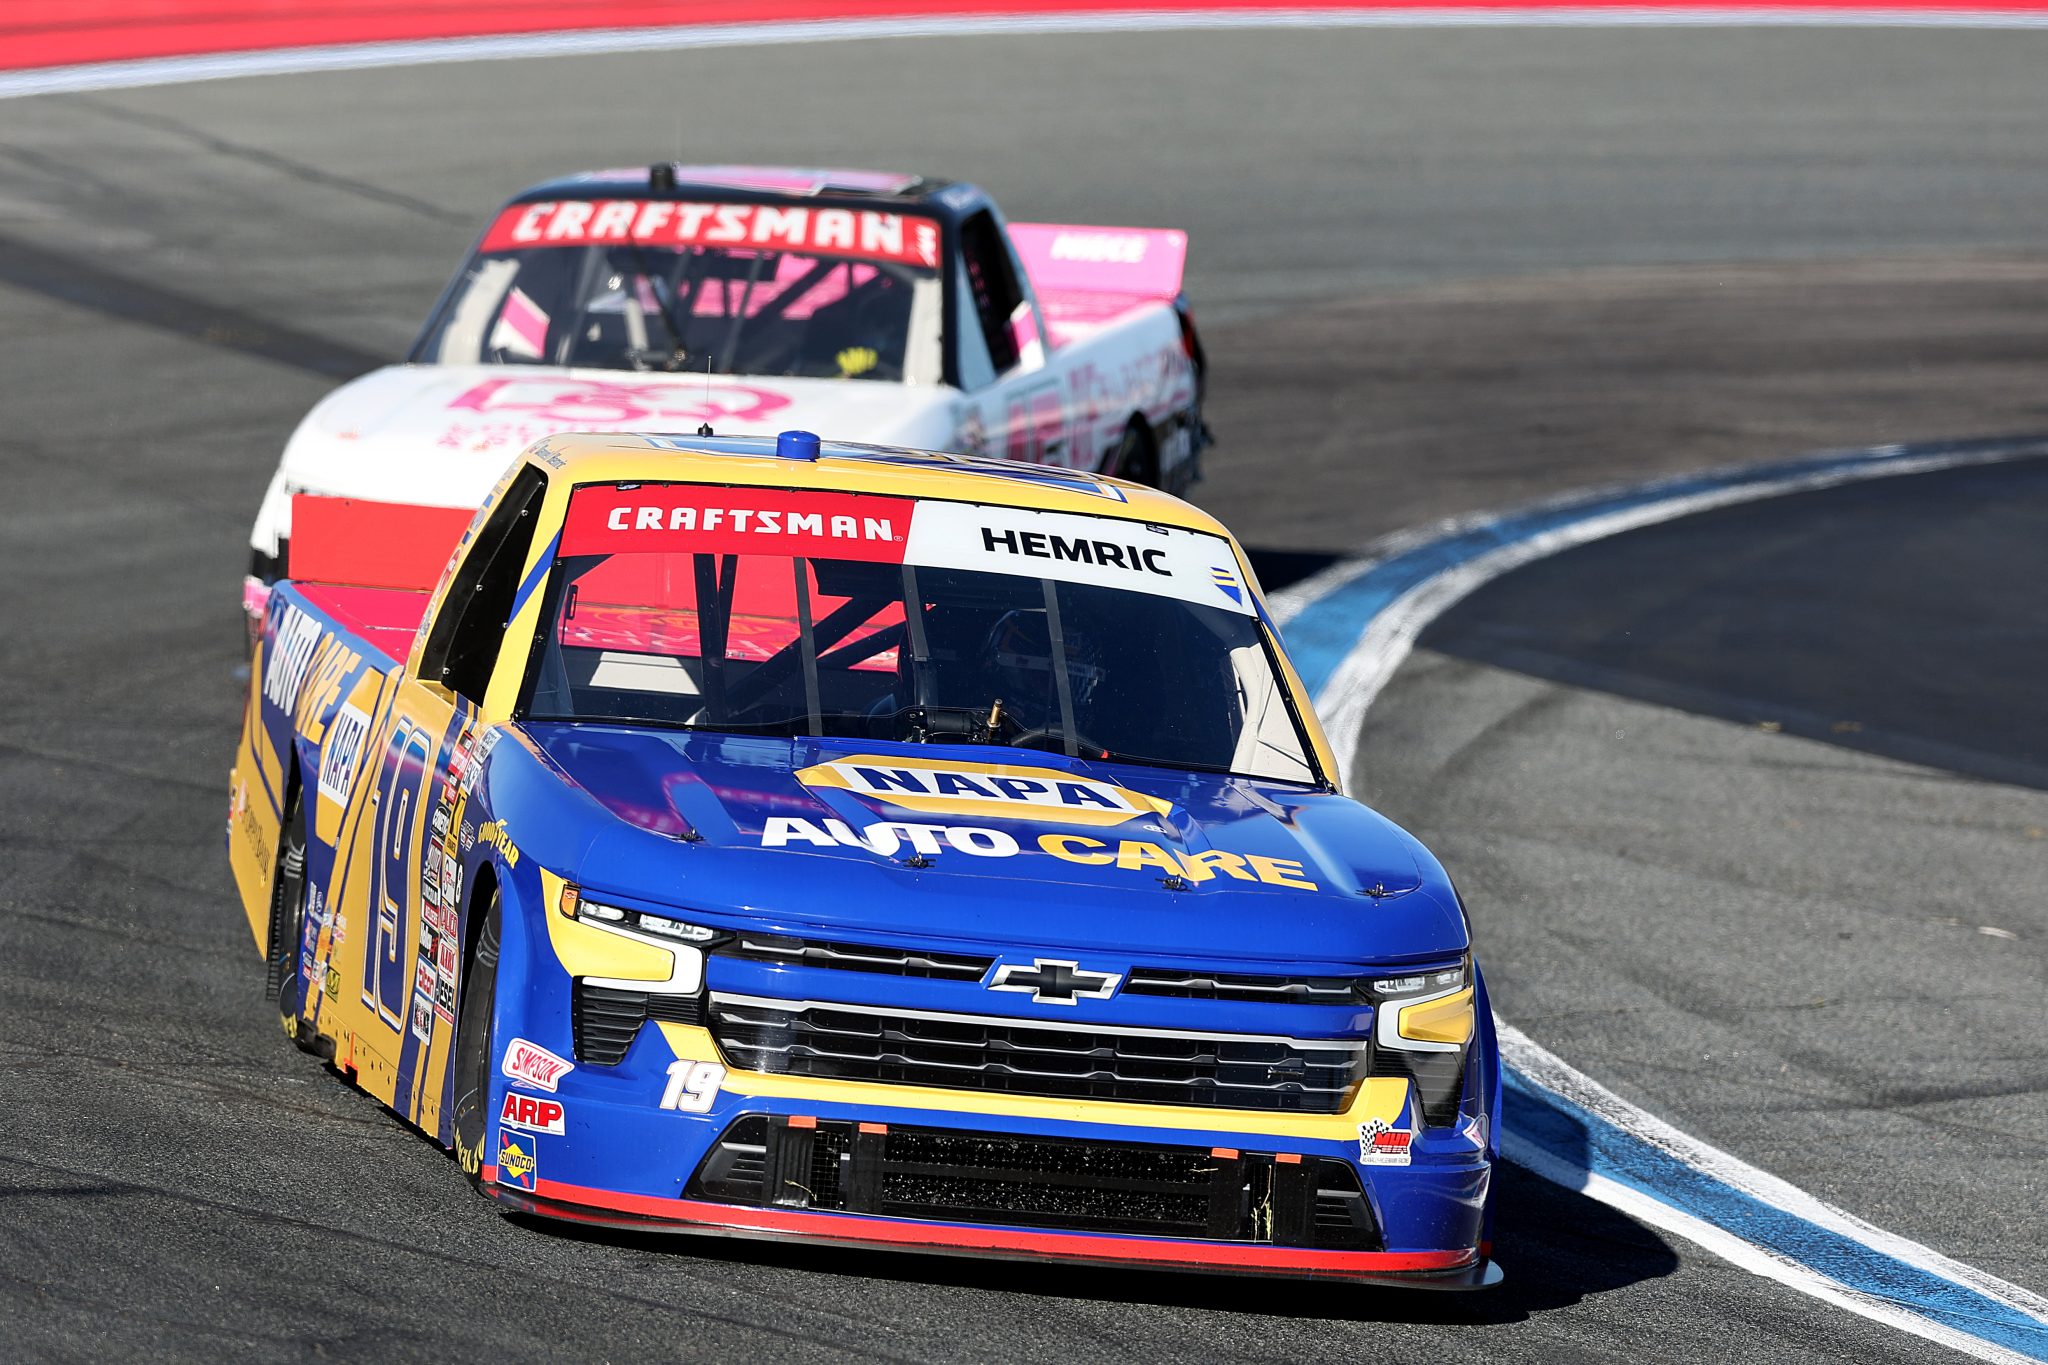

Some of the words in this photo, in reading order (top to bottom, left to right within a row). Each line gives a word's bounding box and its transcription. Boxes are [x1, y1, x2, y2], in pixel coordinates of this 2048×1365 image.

[511, 201, 905, 254] CRAFTSMAN
[607, 506, 894, 542] CRAFTSMAN
[980, 527, 1173, 577] HEMRIC
[264, 603, 323, 717] AUTO
[295, 632, 362, 745] CARE
[322, 711, 364, 798] NAPA
[851, 766, 1127, 811] NAPA
[478, 818, 520, 869] GOODYEAR
[760, 816, 1020, 858] AUTO
[1037, 834, 1319, 892] CARE
[361, 714, 432, 1035] 19
[512, 1046, 564, 1083] SIMPSON
[660, 1059, 728, 1114] 19
[502, 1094, 562, 1127] ARP
[500, 1151, 532, 1171] SUNOCO
